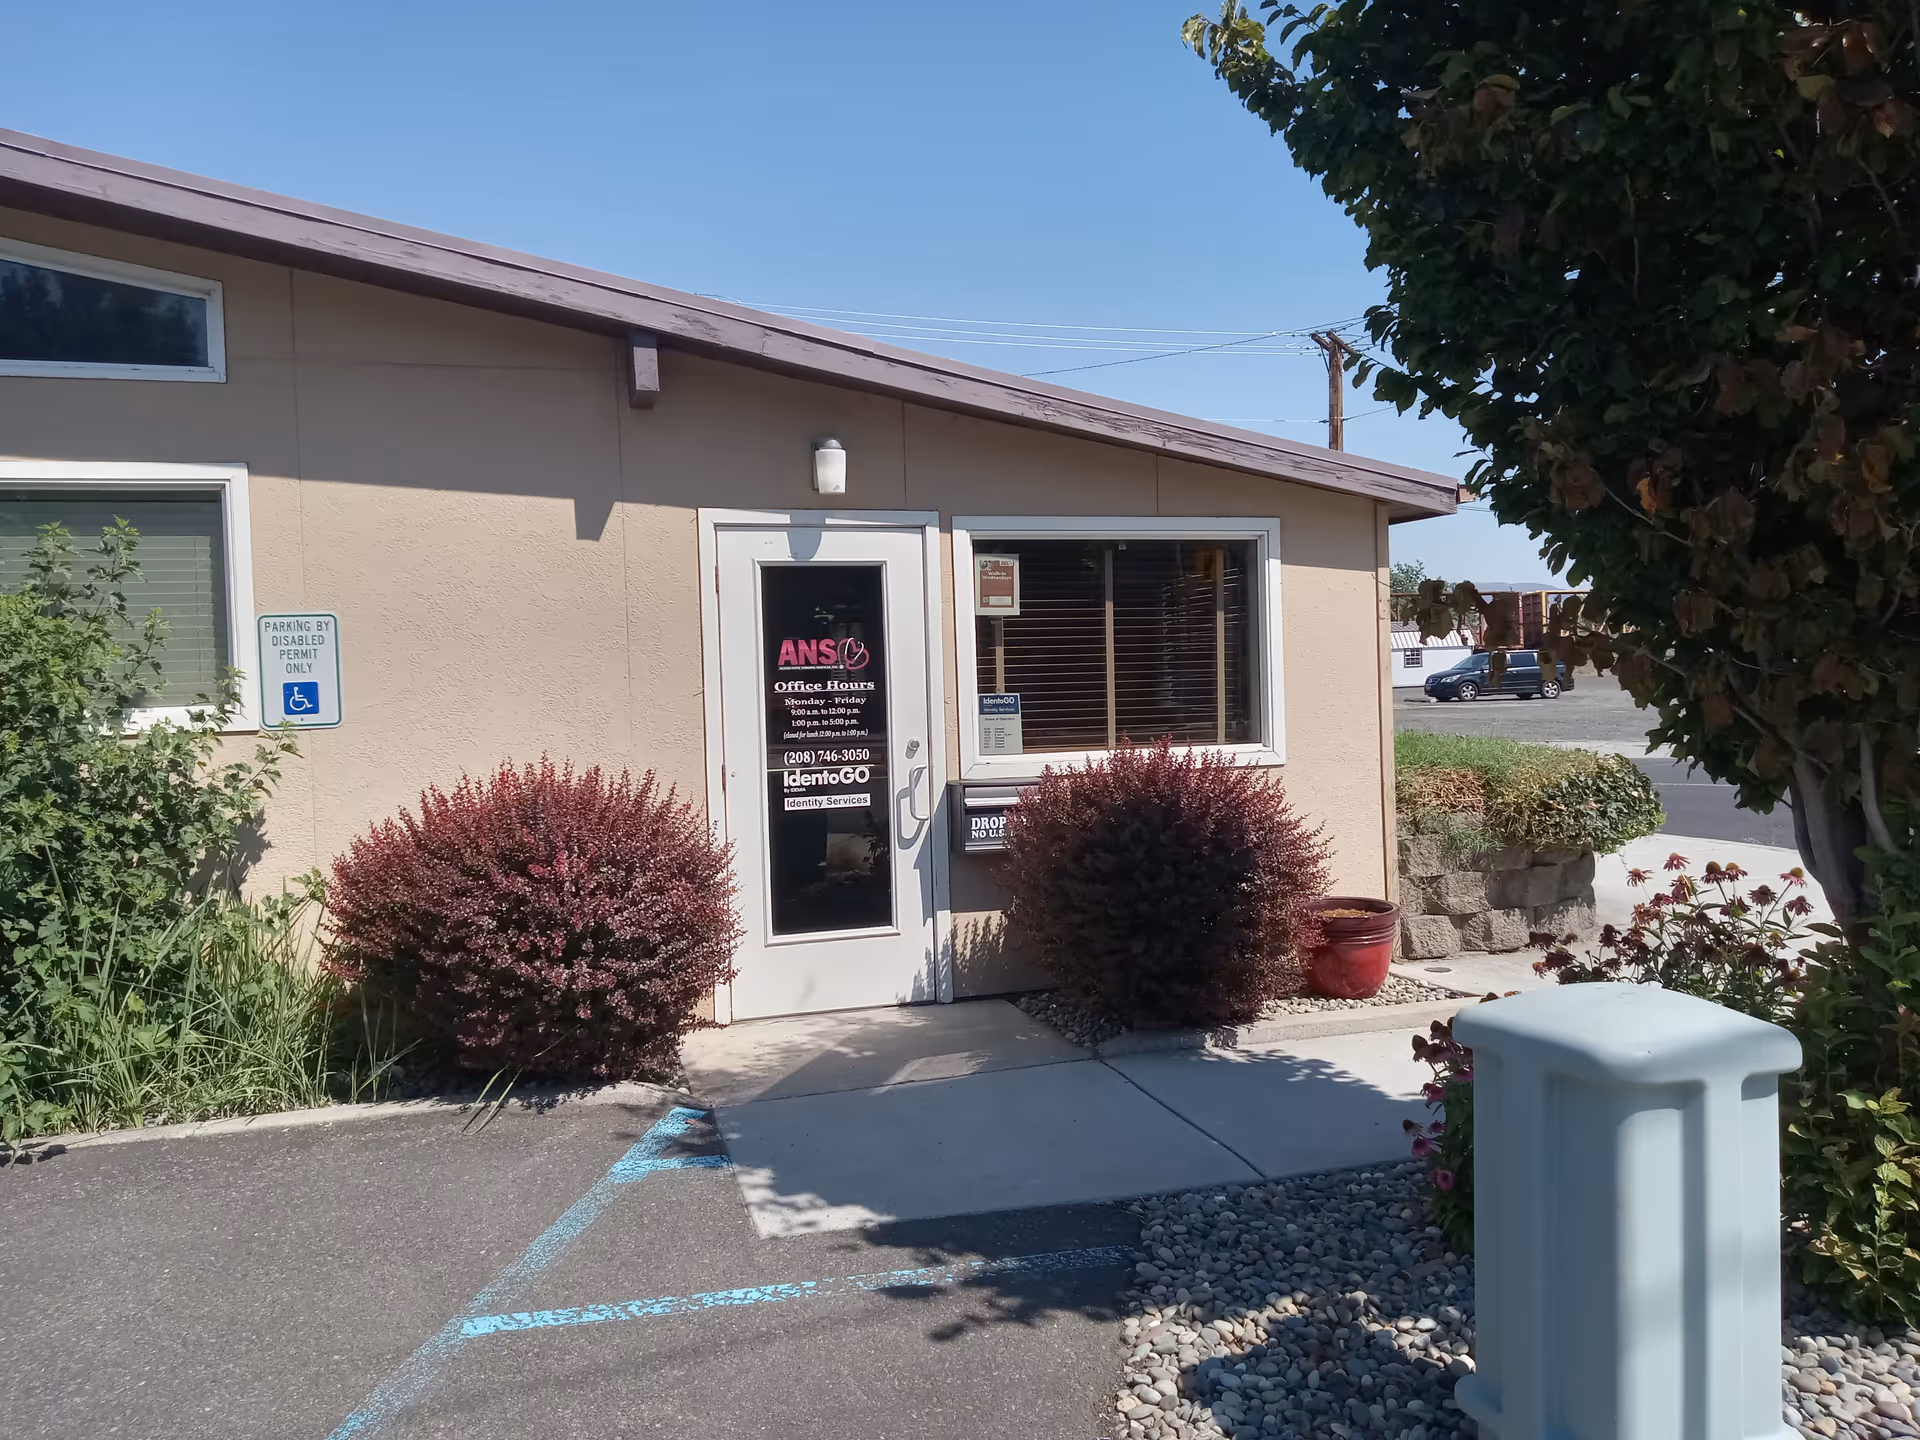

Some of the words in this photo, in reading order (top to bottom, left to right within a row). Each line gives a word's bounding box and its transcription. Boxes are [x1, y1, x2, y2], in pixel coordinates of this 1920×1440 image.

[264, 620, 310, 632] PARKING
[316, 620, 330, 632] BY
[272, 635, 324, 646] DISABLED
[280, 648, 318, 660] PERMIT
[778, 638, 838, 666] ANS
[286, 662, 312, 674] ONLY
[774, 681, 822, 692] Office
[827, 680, 874, 690] Hours
[784, 732, 799, 740] (closed
[784, 750, 816, 766] (208)
[818, 748, 870, 762] 746-3050
[784, 766, 870, 786] IdentoGO
[787, 798, 824, 808] Identity
[826, 796, 868, 806] Services
[971, 816, 1006, 830] DROP
[972, 830, 986, 838] NO
